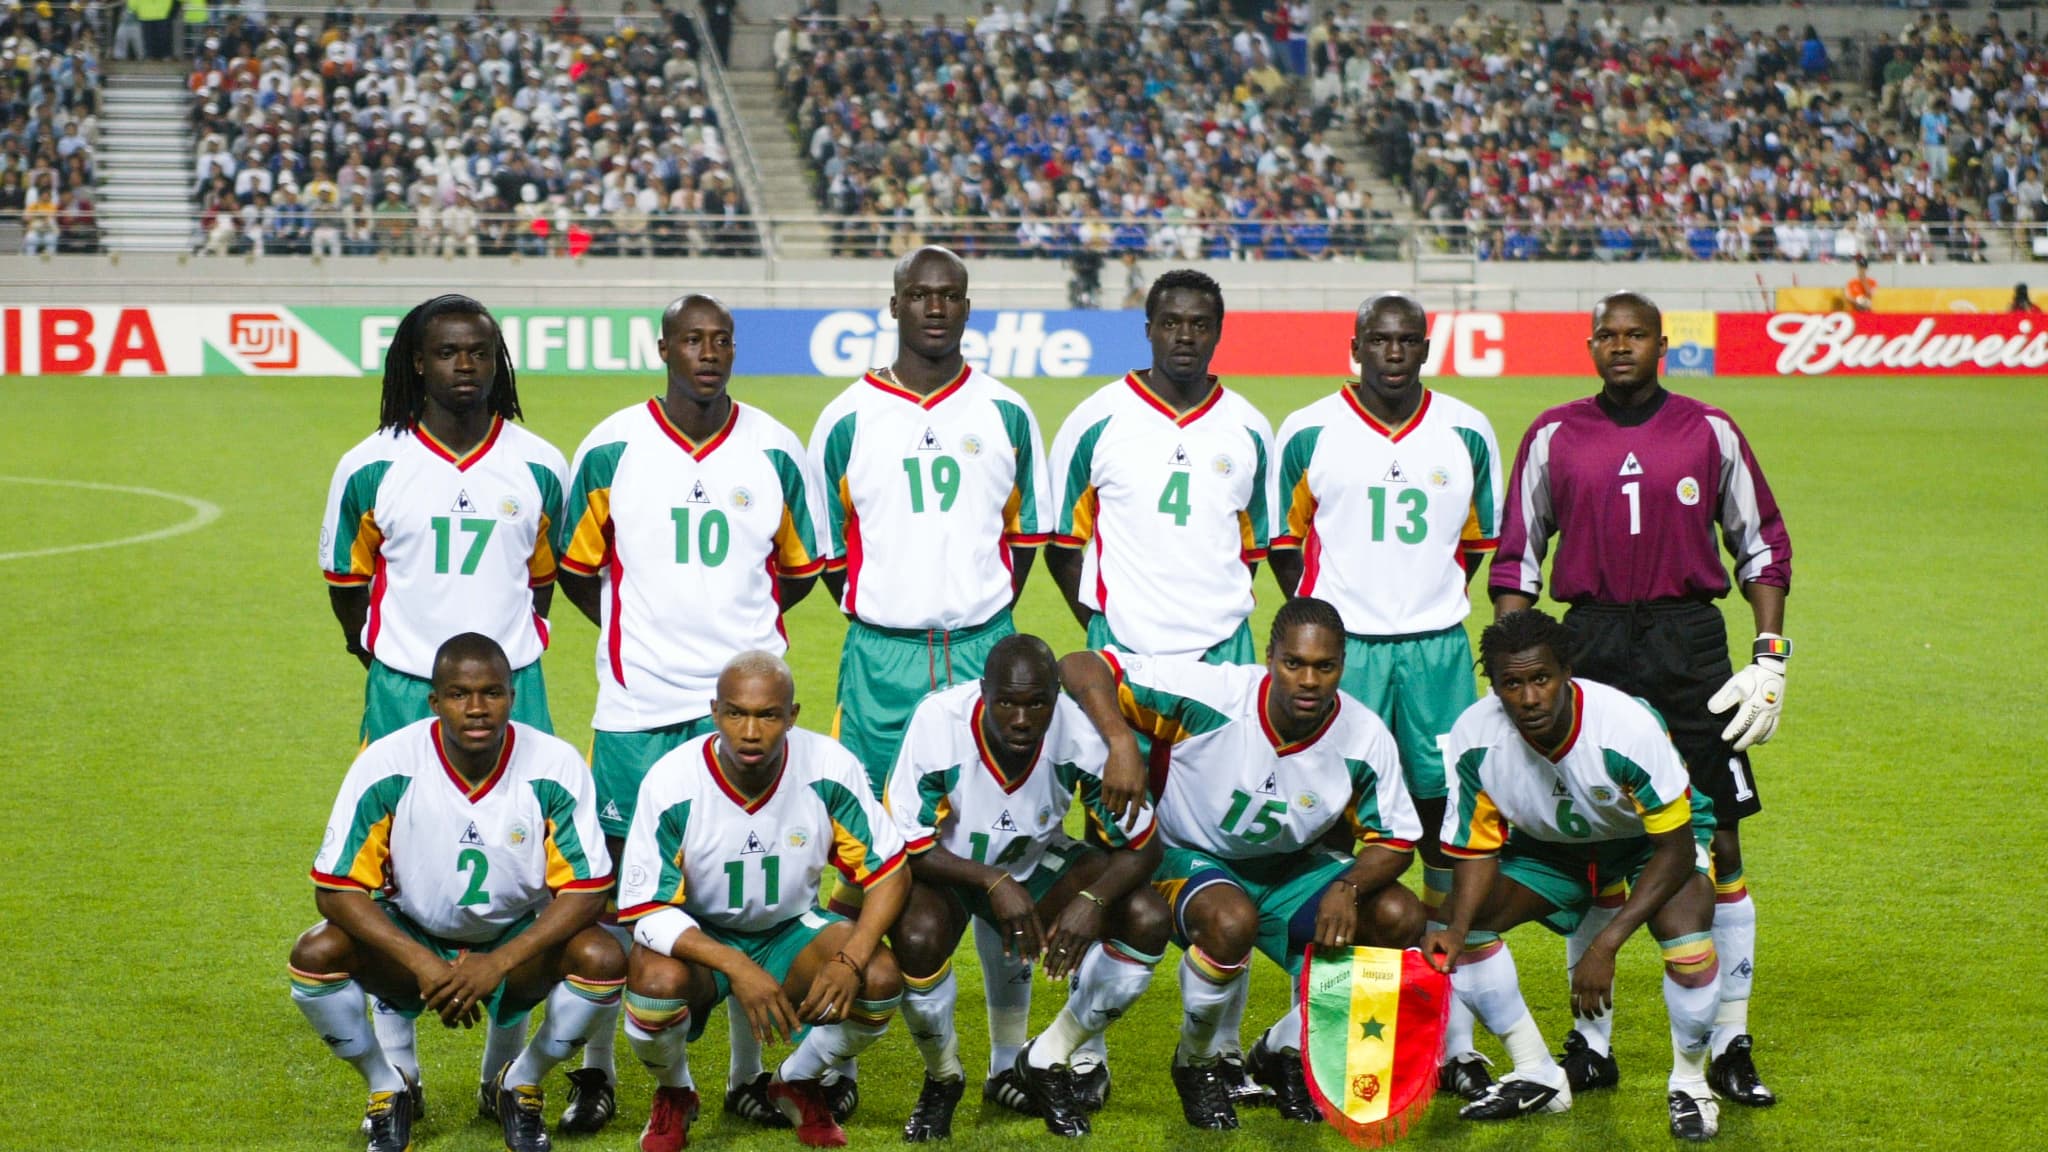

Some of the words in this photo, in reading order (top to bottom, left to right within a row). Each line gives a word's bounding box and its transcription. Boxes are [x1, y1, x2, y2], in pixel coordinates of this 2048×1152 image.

[3, 309, 167, 374] IBA
[230, 313, 297, 368] FUJI
[361, 316, 664, 370] FIFILM
[810, 308, 1092, 377] Giette
[1766, 312, 2048, 374] Budweis
[903, 455, 961, 513] 19
[1158, 471, 1191, 526] 4
[1621, 481, 1641, 535] 1
[671, 508, 729, 567] 10
[1367, 486, 1428, 544] 13
[431, 516, 497, 575] 17
[1728, 757, 1753, 802] 1
[1219, 789, 1287, 843] 15
[1556, 799, 1592, 838] 6
[968, 831, 1033, 865] 14
[457, 848, 490, 906] 2
[724, 855, 780, 908] 11
